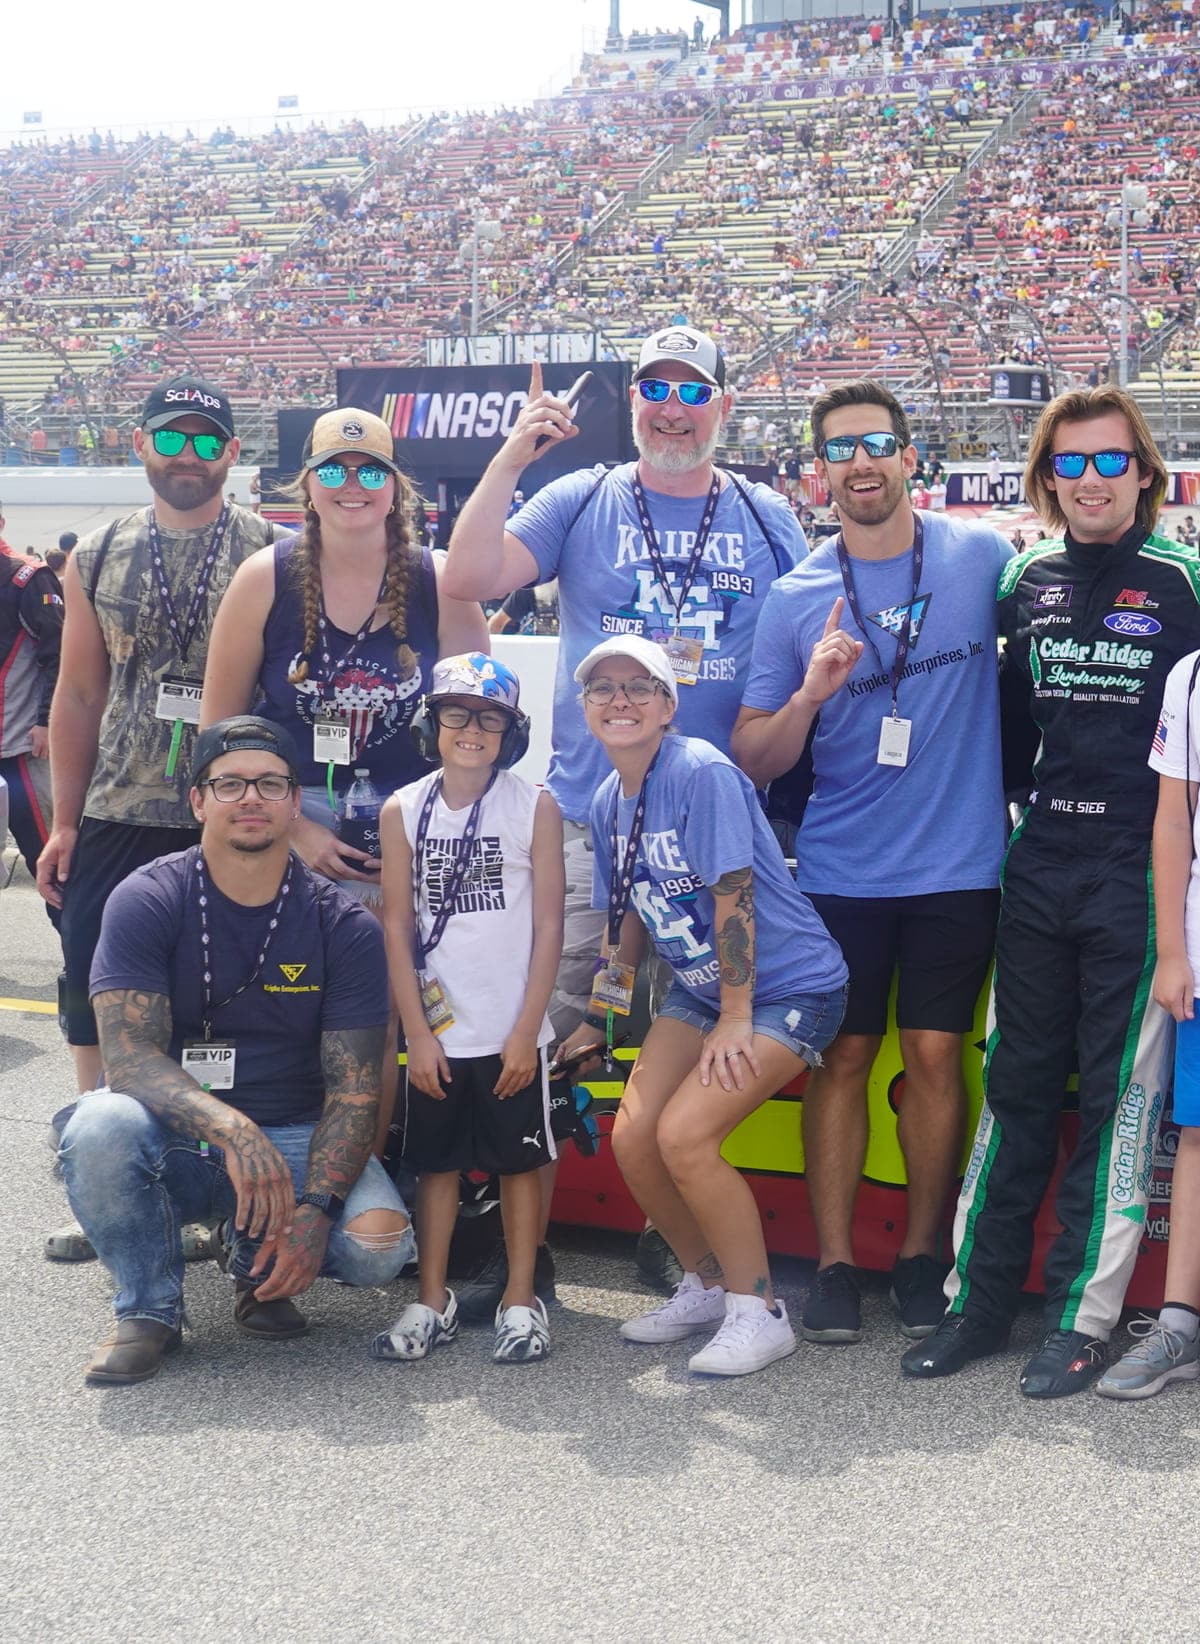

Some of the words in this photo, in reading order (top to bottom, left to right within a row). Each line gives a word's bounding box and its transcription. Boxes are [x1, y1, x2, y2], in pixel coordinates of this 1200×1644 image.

[1021, 70, 1043, 85] ally
[784, 84, 805, 99] ally
[165, 389, 221, 409] SciAps
[424, 392, 580, 440] NASC
[712, 572, 753, 594] 1993
[602, 615, 644, 634] SINCE
[1114, 614, 1151, 633] Ford
[1039, 636, 1090, 662] Cedar
[1091, 640, 1154, 669] Ridge
[848, 673, 890, 698] Kripke
[892, 648, 968, 681] nterprises,
[1046, 663, 1145, 693] Landscaping
[1073, 693, 1099, 702] QUALITY
[1100, 694, 1139, 704] INSTALLATION
[332, 728, 348, 740] VIP
[1050, 798, 1075, 812] KYLE
[1076, 801, 1106, 814] SIEG
[660, 874, 705, 899] 1993
[210, 1050, 232, 1061] VIP
[1117, 1082, 1146, 1142] Ridge
[1112, 1142, 1137, 1203] Cedar
